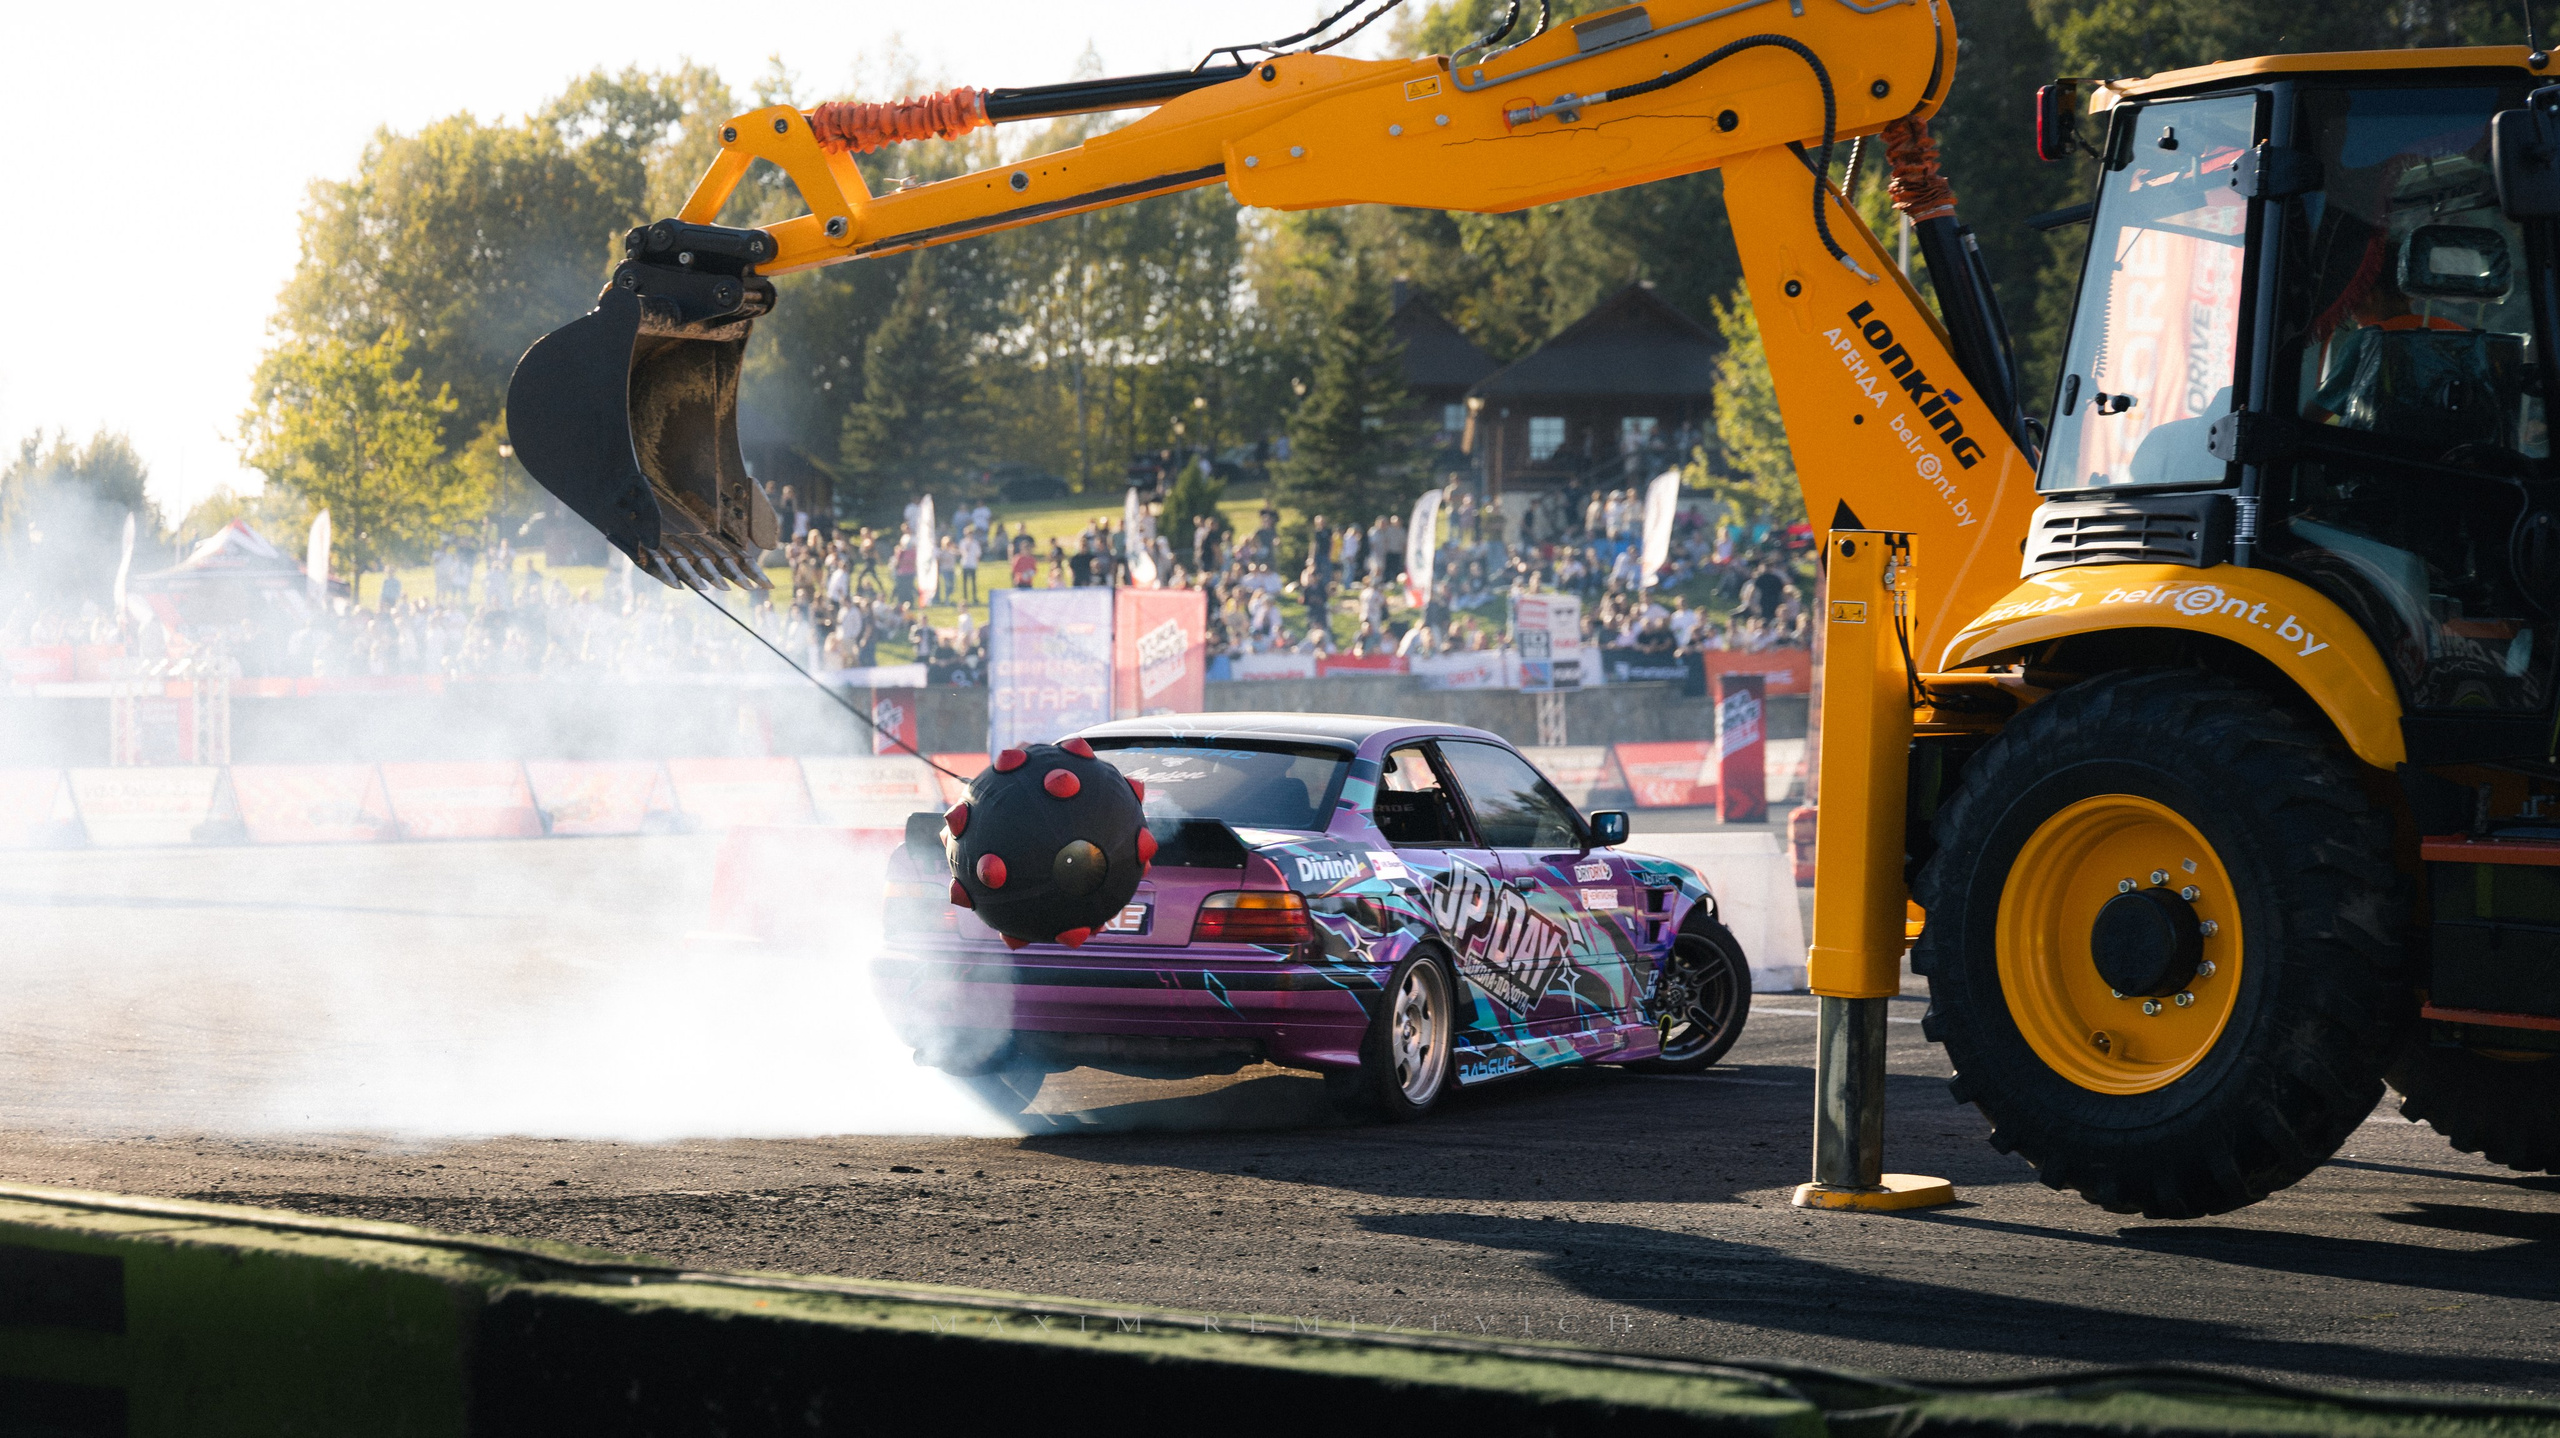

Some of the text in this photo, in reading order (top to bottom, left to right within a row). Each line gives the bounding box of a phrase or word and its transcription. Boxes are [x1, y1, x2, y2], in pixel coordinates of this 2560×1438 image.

[1823, 328, 1889, 409] АРЕНДА
[2186, 302, 2212, 414] DRIVE
[996, 686, 1107, 711] СТАРТ
[1295, 853, 1362, 882] Divinol
[1487, 889, 1563, 991] DAY
